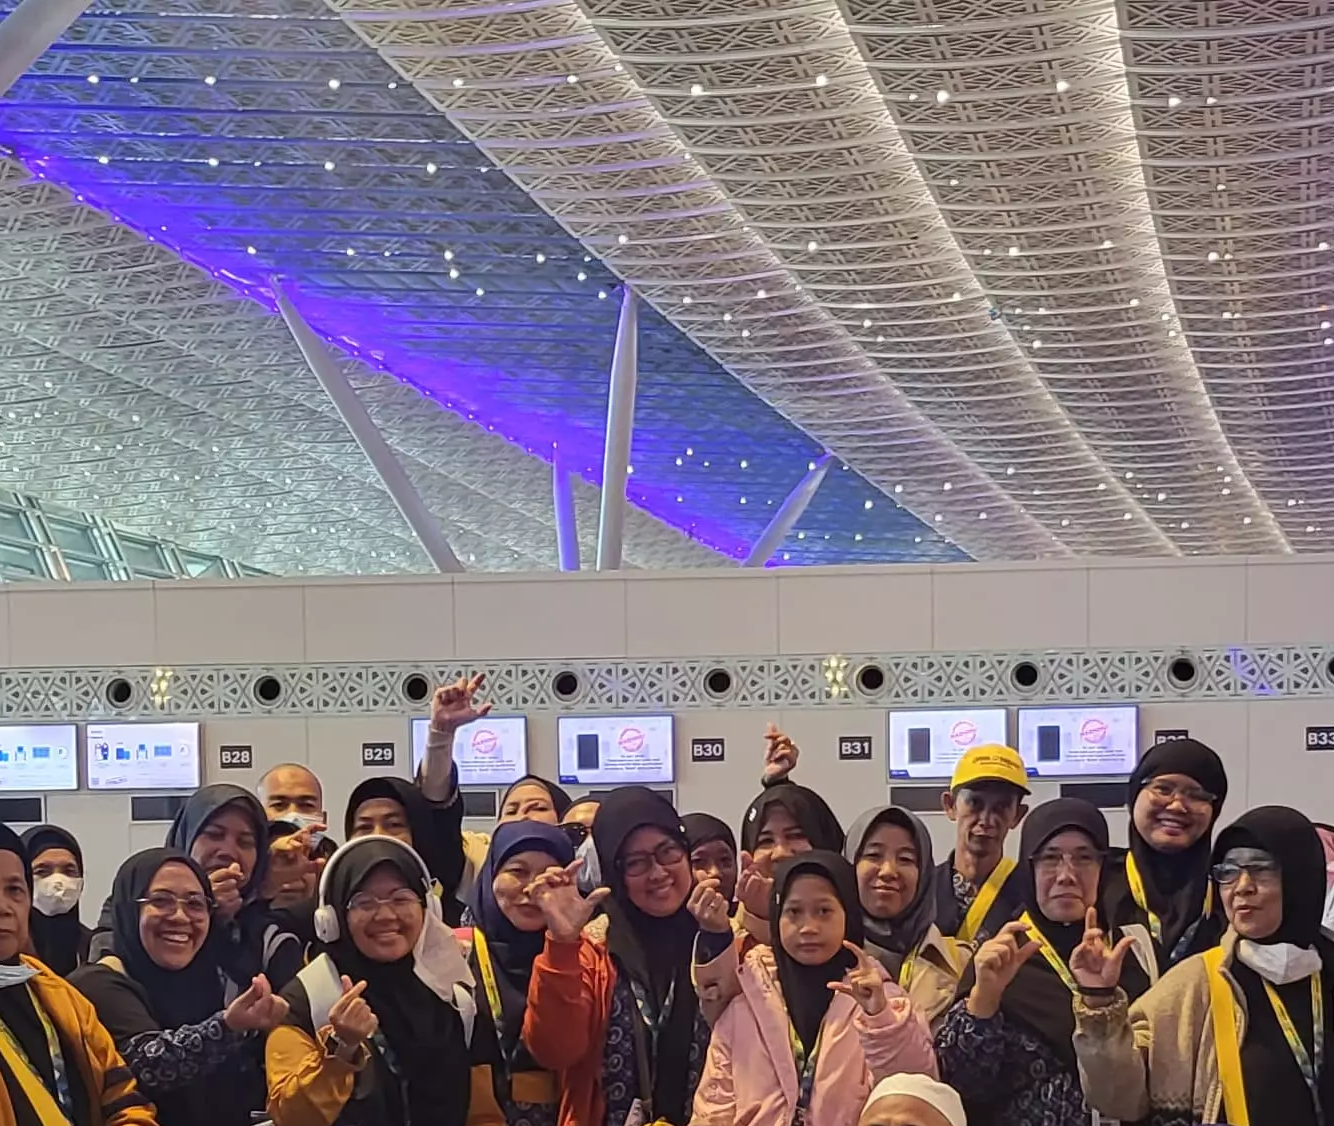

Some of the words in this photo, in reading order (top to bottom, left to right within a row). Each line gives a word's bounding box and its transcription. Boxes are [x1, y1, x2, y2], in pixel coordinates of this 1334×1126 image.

[364, 748, 393, 761] B29
[694, 744, 722, 757] B30
[841, 742, 869, 755] B31
[222, 750, 251, 764] B28
